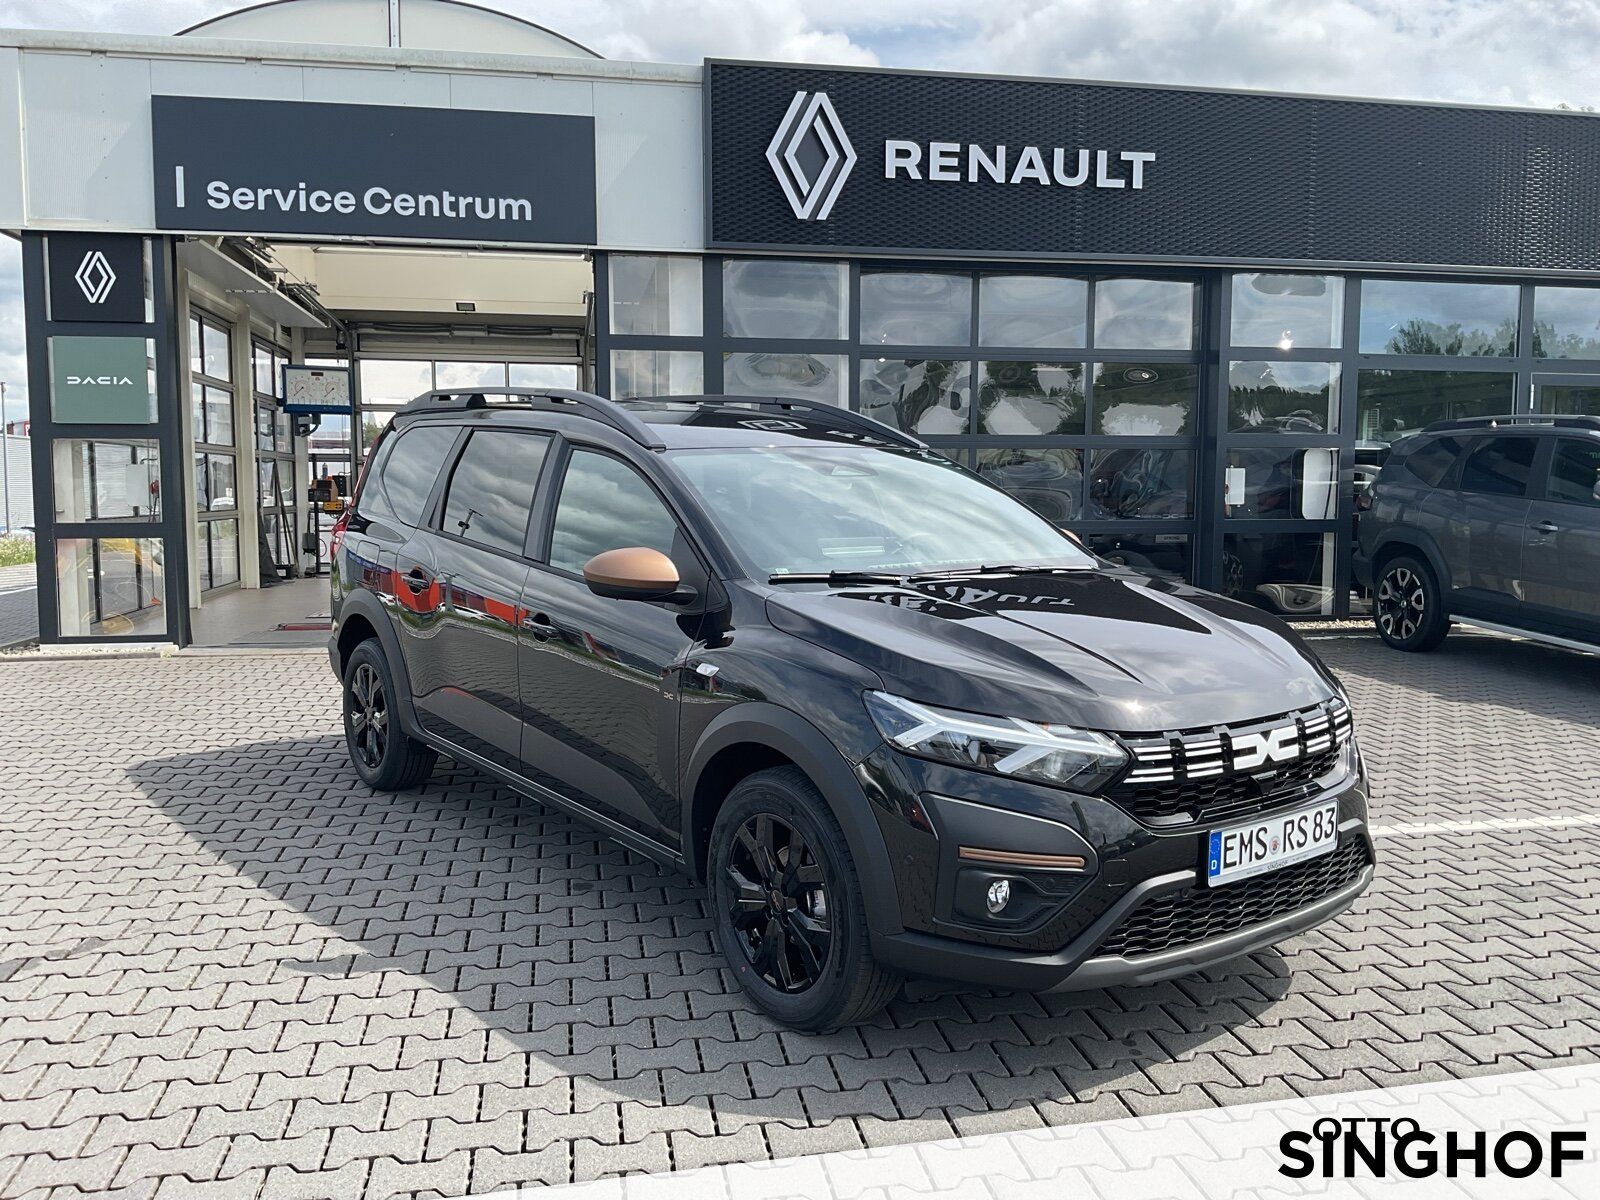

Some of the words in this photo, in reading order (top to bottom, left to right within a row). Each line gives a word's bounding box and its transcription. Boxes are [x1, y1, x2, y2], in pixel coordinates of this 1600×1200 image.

[885, 139, 1156, 190] RENAULT
[206, 180, 356, 214] Service
[363, 186, 532, 221] Centrum
[66, 376, 134, 385] DACIA
[1223, 826, 1268, 869] EMS
[1283, 814, 1308, 853] RS
[1312, 806, 1336, 843] 83
[1211, 859, 1218, 870] D
